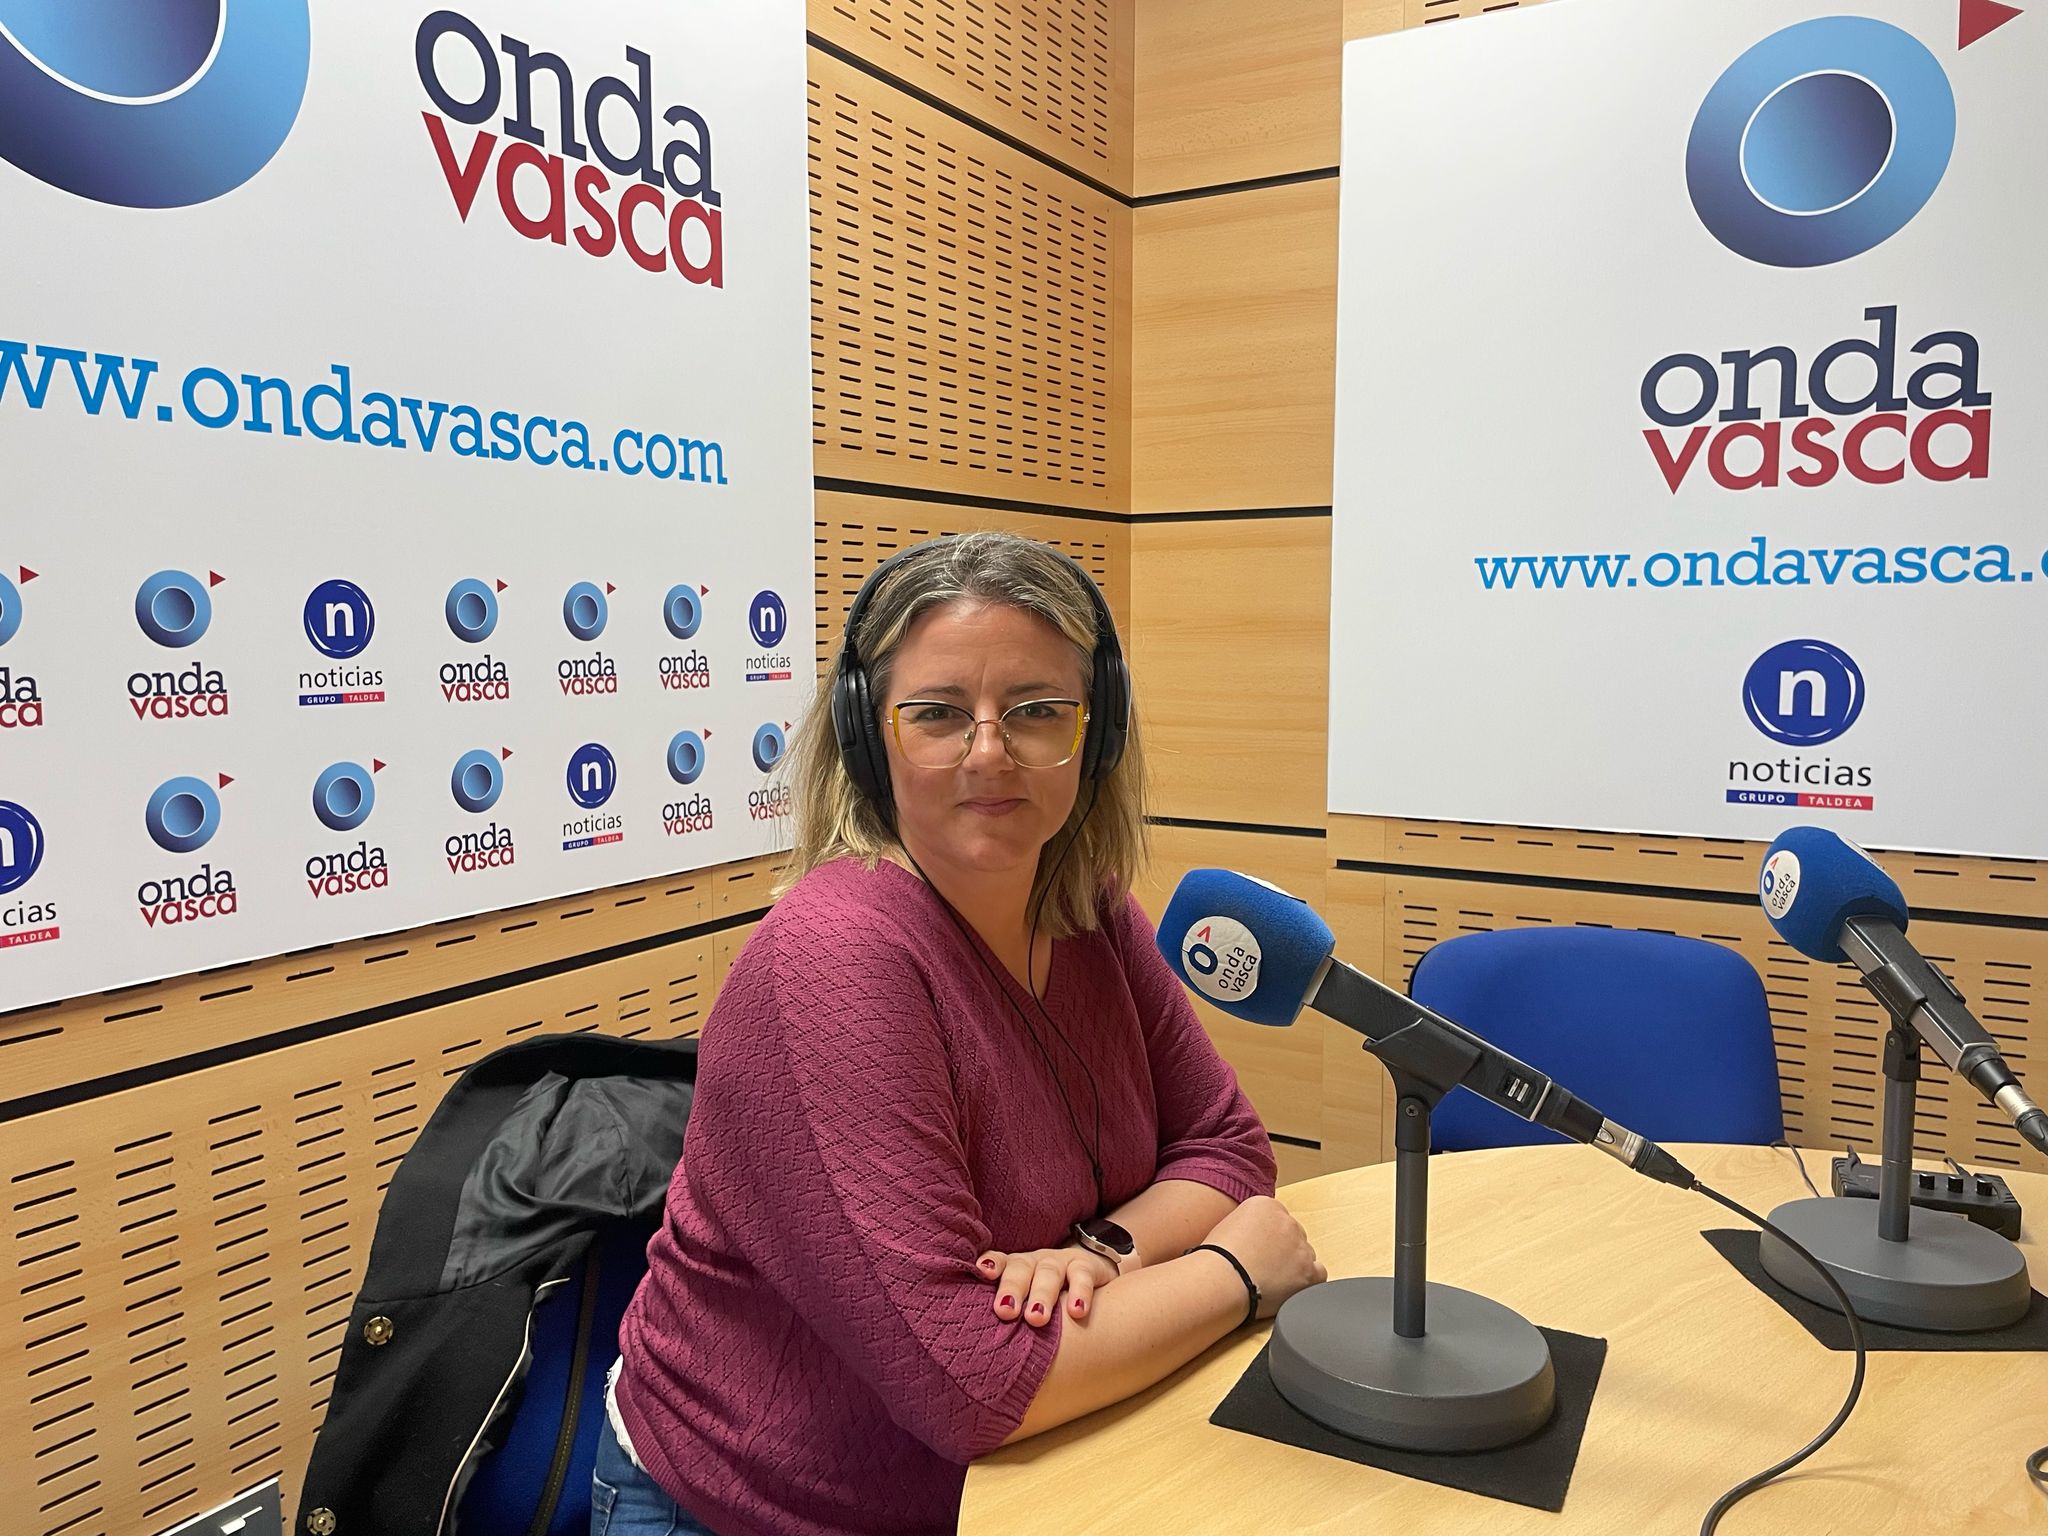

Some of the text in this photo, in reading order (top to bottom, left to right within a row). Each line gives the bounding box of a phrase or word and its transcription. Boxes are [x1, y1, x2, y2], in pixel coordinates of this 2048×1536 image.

[415, 10, 722, 207] onda
[422, 111, 724, 289] vasca
[1640, 304, 1993, 427] onda
[1643, 408, 1992, 495] vasca
[1474, 536, 2048, 590] www.ondavasca.
[439, 654, 509, 685] onda
[557, 652, 617, 680] onda
[658, 650, 710, 678] onda
[746, 652, 791, 669] noticias
[127, 662, 228, 699] onda
[299, 665, 383, 689] noticias
[441, 680, 510, 703] vasca
[559, 675, 618, 697] vasca
[660, 671, 710, 690] vasca
[129, 692, 229, 721] vasca
[306, 693, 380, 704] GRUPO TALDEA
[1729, 756, 1872, 787] noticias
[662, 793, 713, 822] onda
[748, 781, 790, 806] onda
[1738, 792, 1863, 808] GRUPO TALDEA
[563, 812, 623, 837] noticias
[663, 813, 713, 837] vasca
[445, 823, 514, 857] onda
[305, 841, 388, 880] onda
[446, 846, 515, 875] vasca
[137, 864, 236, 906] onda
[307, 864, 389, 899] vasca
[1772, 873, 1791, 907] onda
[1777, 880, 1796, 910] vasca
[139, 890, 238, 929] vasca
[8, 931, 52, 945] TALDEA
[1218, 946, 1246, 989] onda
[1230, 954, 1258, 993] vasca
